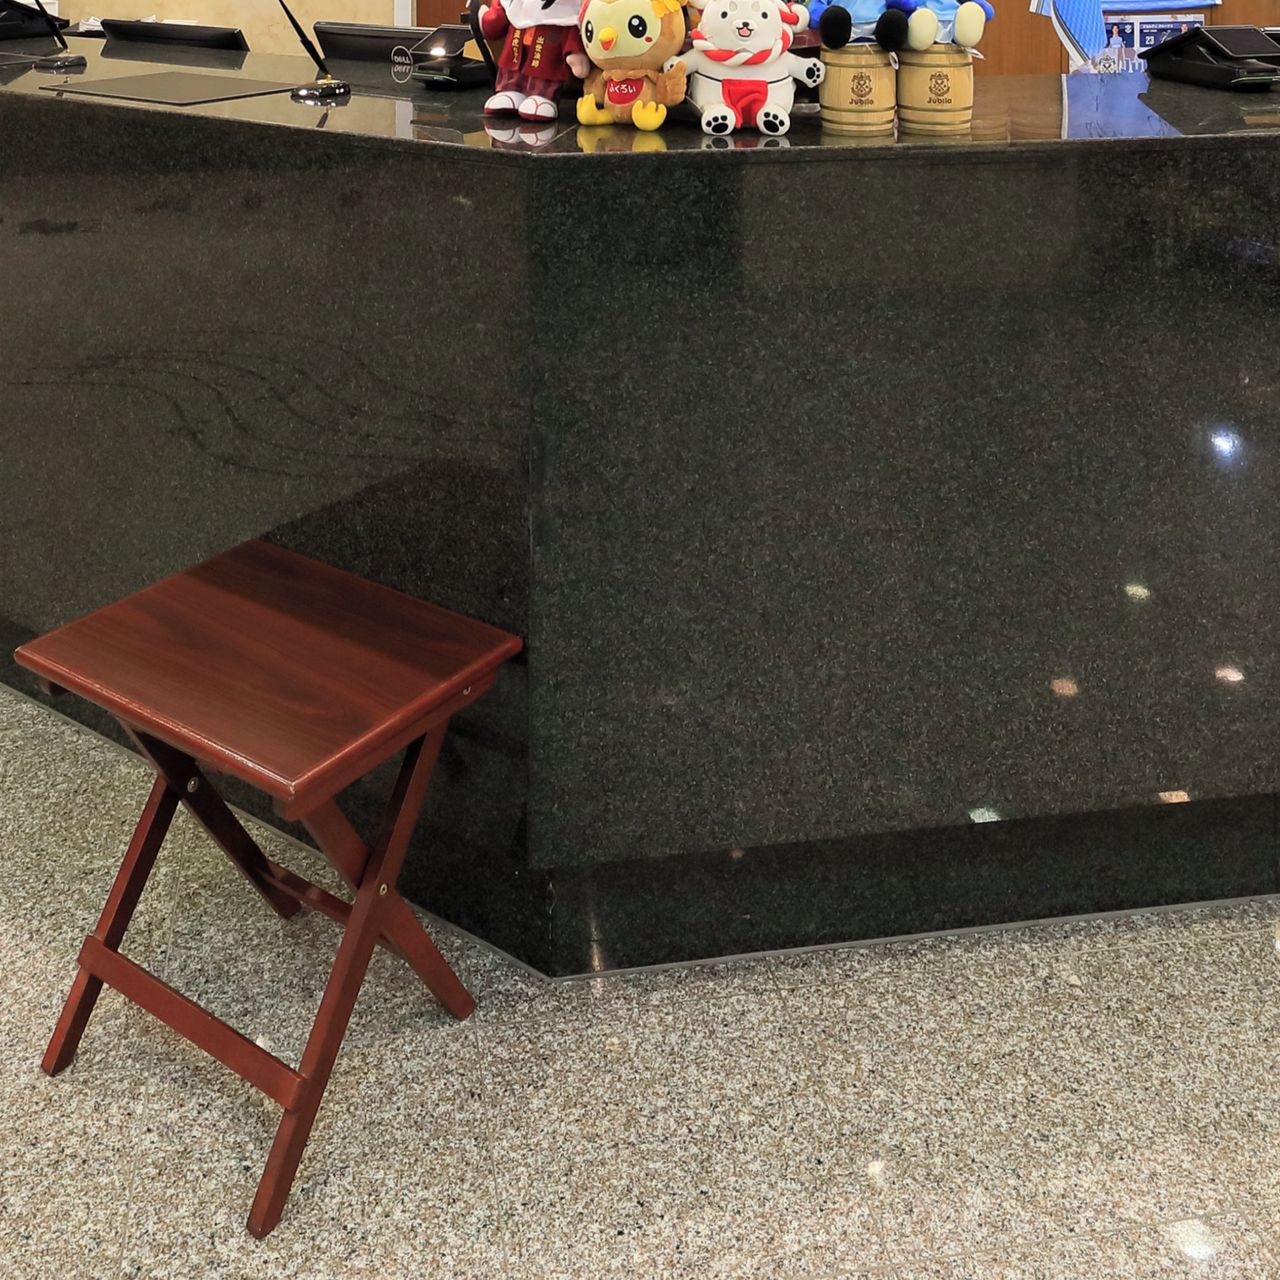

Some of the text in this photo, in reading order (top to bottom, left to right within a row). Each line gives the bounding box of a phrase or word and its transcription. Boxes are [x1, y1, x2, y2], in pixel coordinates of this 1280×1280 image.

[1145, 36, 1155, 45] 23
[609, 83, 637, 94] ふくろい
